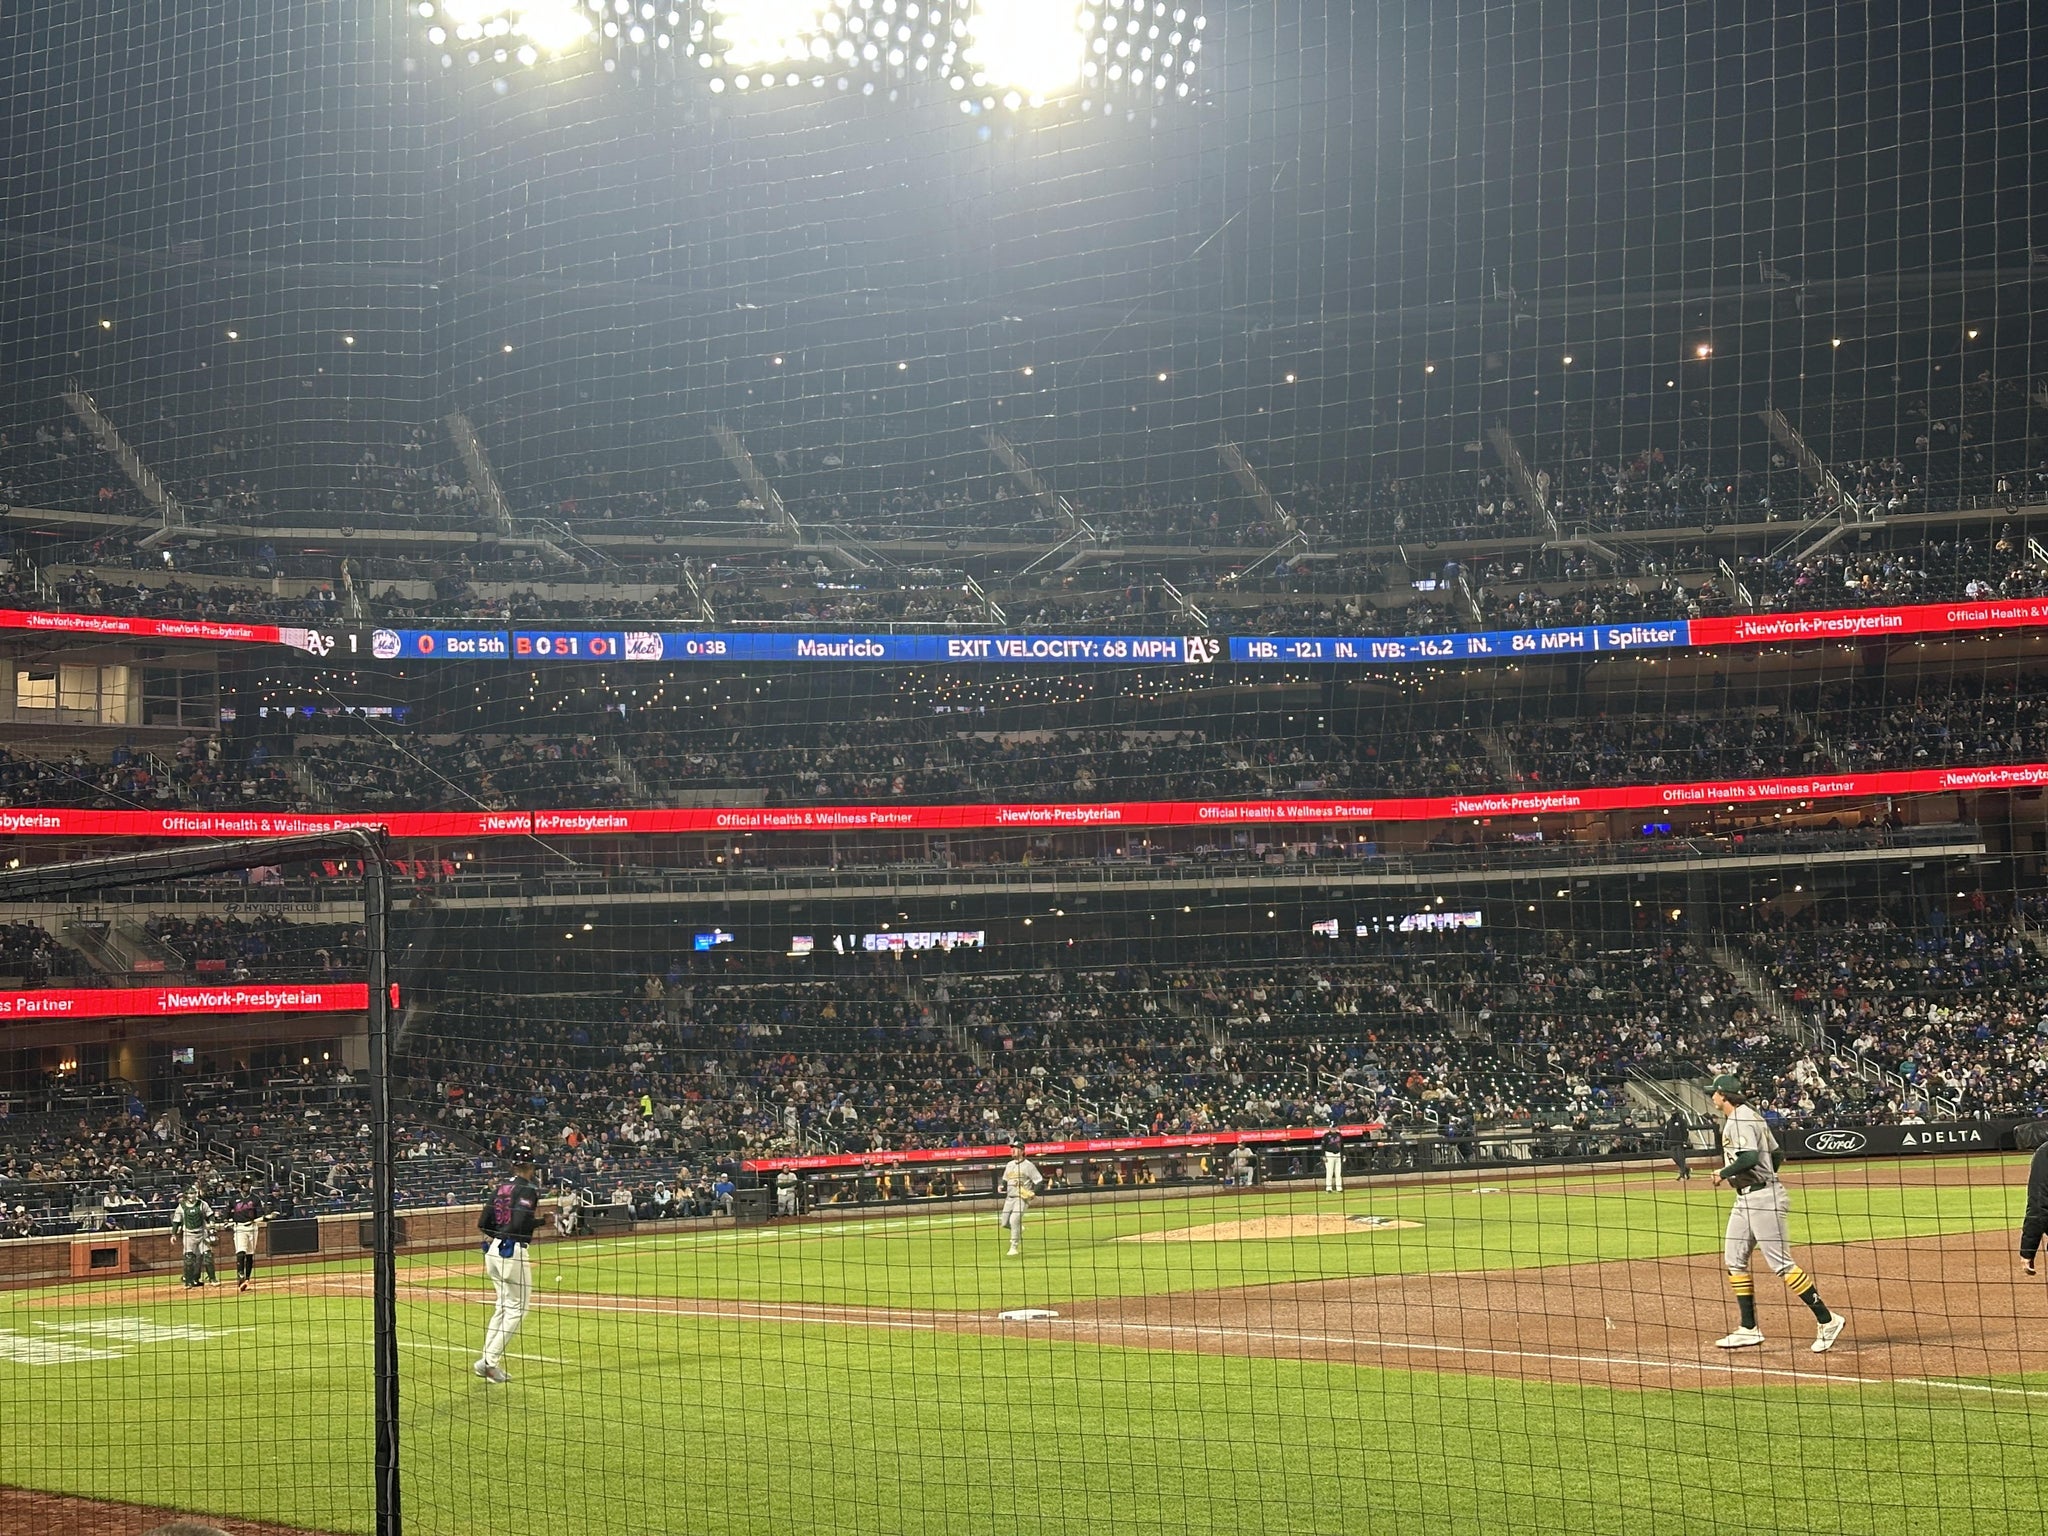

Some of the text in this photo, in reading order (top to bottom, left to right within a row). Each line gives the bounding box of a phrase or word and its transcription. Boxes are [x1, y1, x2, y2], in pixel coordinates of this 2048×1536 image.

[1948, 610, 1988, 621] Official
[1991, 608, 2028, 618] Health
[2031, 607, 2039, 616] &
[1745, 614, 1902, 635] NewYork-Presbyterian
[348, 634, 358, 653] 1
[418, 634, 435, 654] 0
[448, 638, 504, 652] Bot 5th
[516, 637, 532, 655] B
[798, 639, 884, 656] Mauricio
[949, 640, 1176, 657] EXIT VELOCITY: 68 MPH
[1249, 643, 1277, 657] HB:
[1287, 642, 1321, 657] -12.1
[1335, 643, 1357, 657] IN.
[1372, 643, 1405, 657] IVB:
[1410, 640, 1453, 655] -16.2
[1468, 638, 1492, 653] IN.
[1513, 635, 1535, 650] 84
[1542, 632, 1583, 648] MPH
[1609, 628, 1676, 648] Splitter
[1663, 782, 1854, 801] Official Health & Wellness Partner
[1199, 805, 1373, 818] Official Health & Wellness Partner
[1458, 795, 1580, 812] NewYork-Presbyterian
[717, 812, 912, 825] Official Health & Wellness Partner
[1003, 808, 1120, 821] NewYork-Presbyterian
[163, 818, 211, 829] Official
[215, 819, 257, 830] Health
[261, 819, 270, 831] &
[275, 819, 330, 832] Wellness
[488, 815, 627, 831] NewYork-Presbyterian
[17, 999, 73, 1011] Partner
[168, 990, 321, 1009] NewYork-Presbyterian
[1816, 1134, 1855, 1150] Ford
[1921, 1129, 1982, 1144] DELTA
